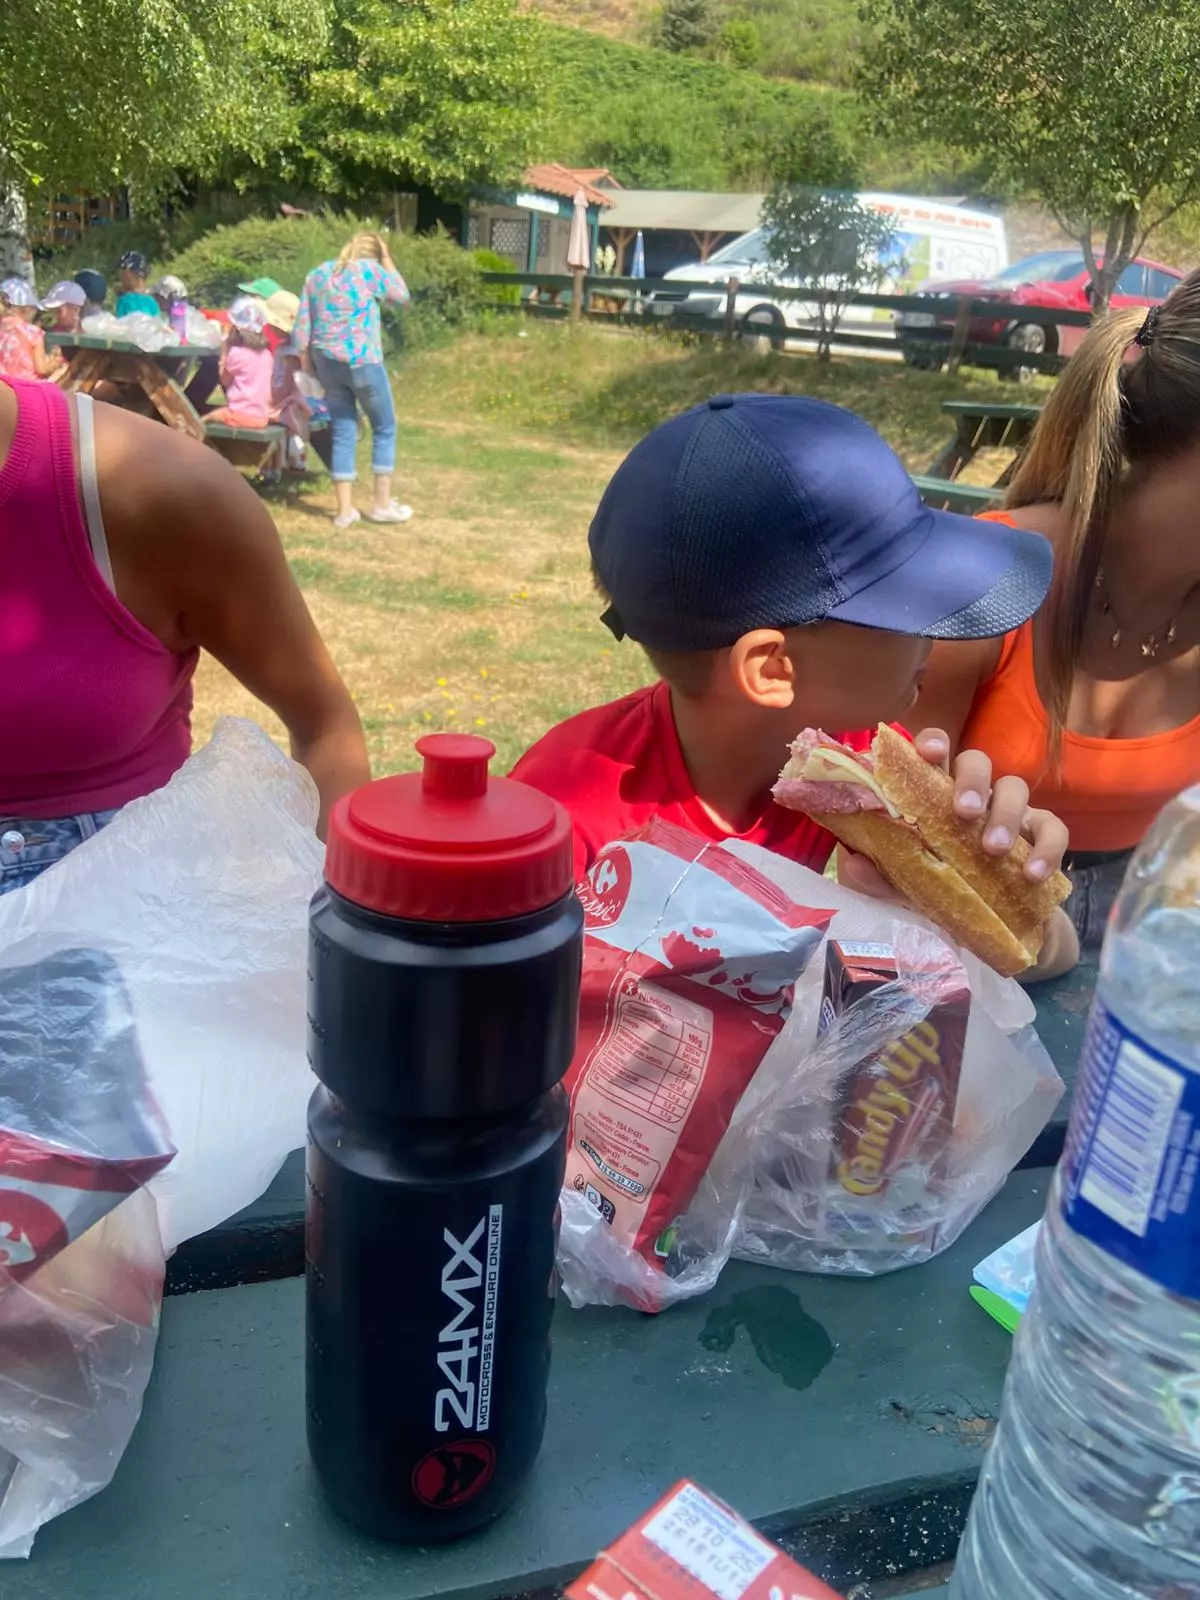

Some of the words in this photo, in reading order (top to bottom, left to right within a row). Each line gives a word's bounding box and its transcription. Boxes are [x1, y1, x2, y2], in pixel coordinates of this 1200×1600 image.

[489, 1214, 500, 1267] ONLINE
[435, 1216, 485, 1432] 24MX
[485, 1271, 497, 1329] ENDURO
[479, 1341, 492, 1427] MOTOCROSS
[673, 1505, 700, 1529] 28
[703, 1525, 725, 1548] 10
